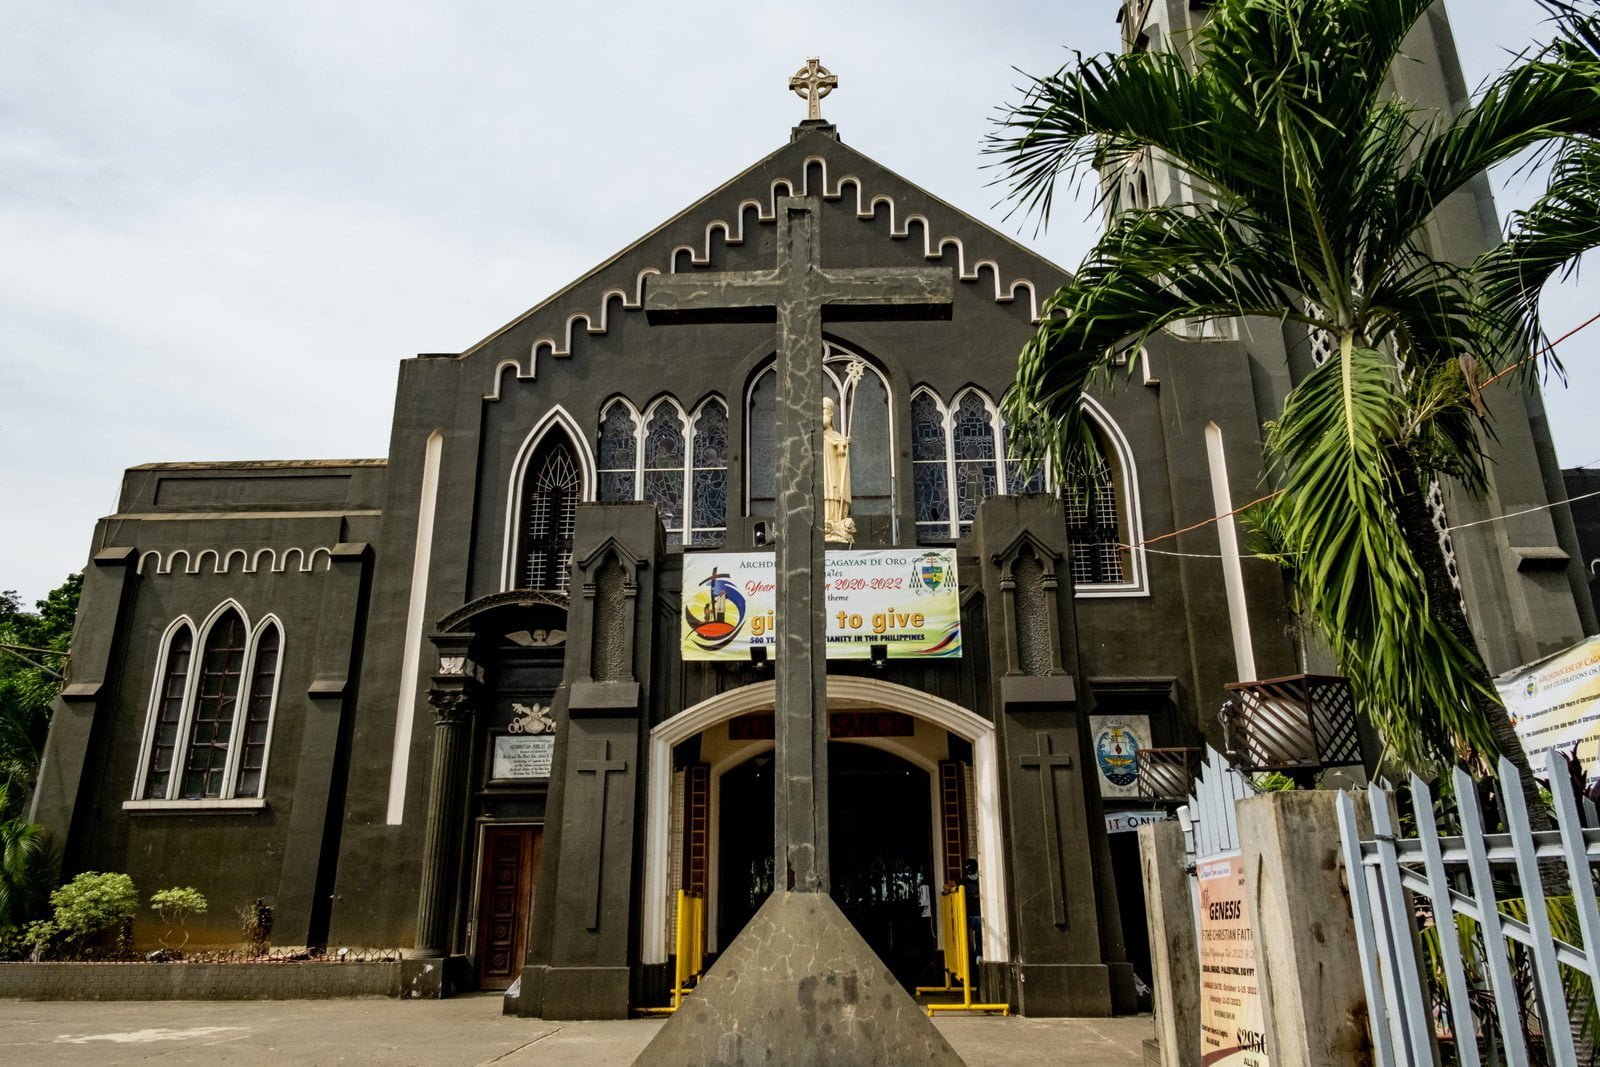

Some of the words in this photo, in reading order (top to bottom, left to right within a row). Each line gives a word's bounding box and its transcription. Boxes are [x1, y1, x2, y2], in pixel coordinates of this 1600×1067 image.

[825, 558, 867, 566] CAGAYAN
[886, 558, 907, 566] ORO
[745, 580, 776, 596] Year
[834, 578, 903, 590] 2020-2022
[751, 610, 774, 636] gi
[836, 611, 863, 629] to
[872, 607, 925, 634] give
[1589, 668, 1598, 676] ON
[1210, 900, 1241, 920] GENESIS
[1213, 929, 1236, 940] CHRISTIAN
[1241, 968, 1254, 976] EGYPT
